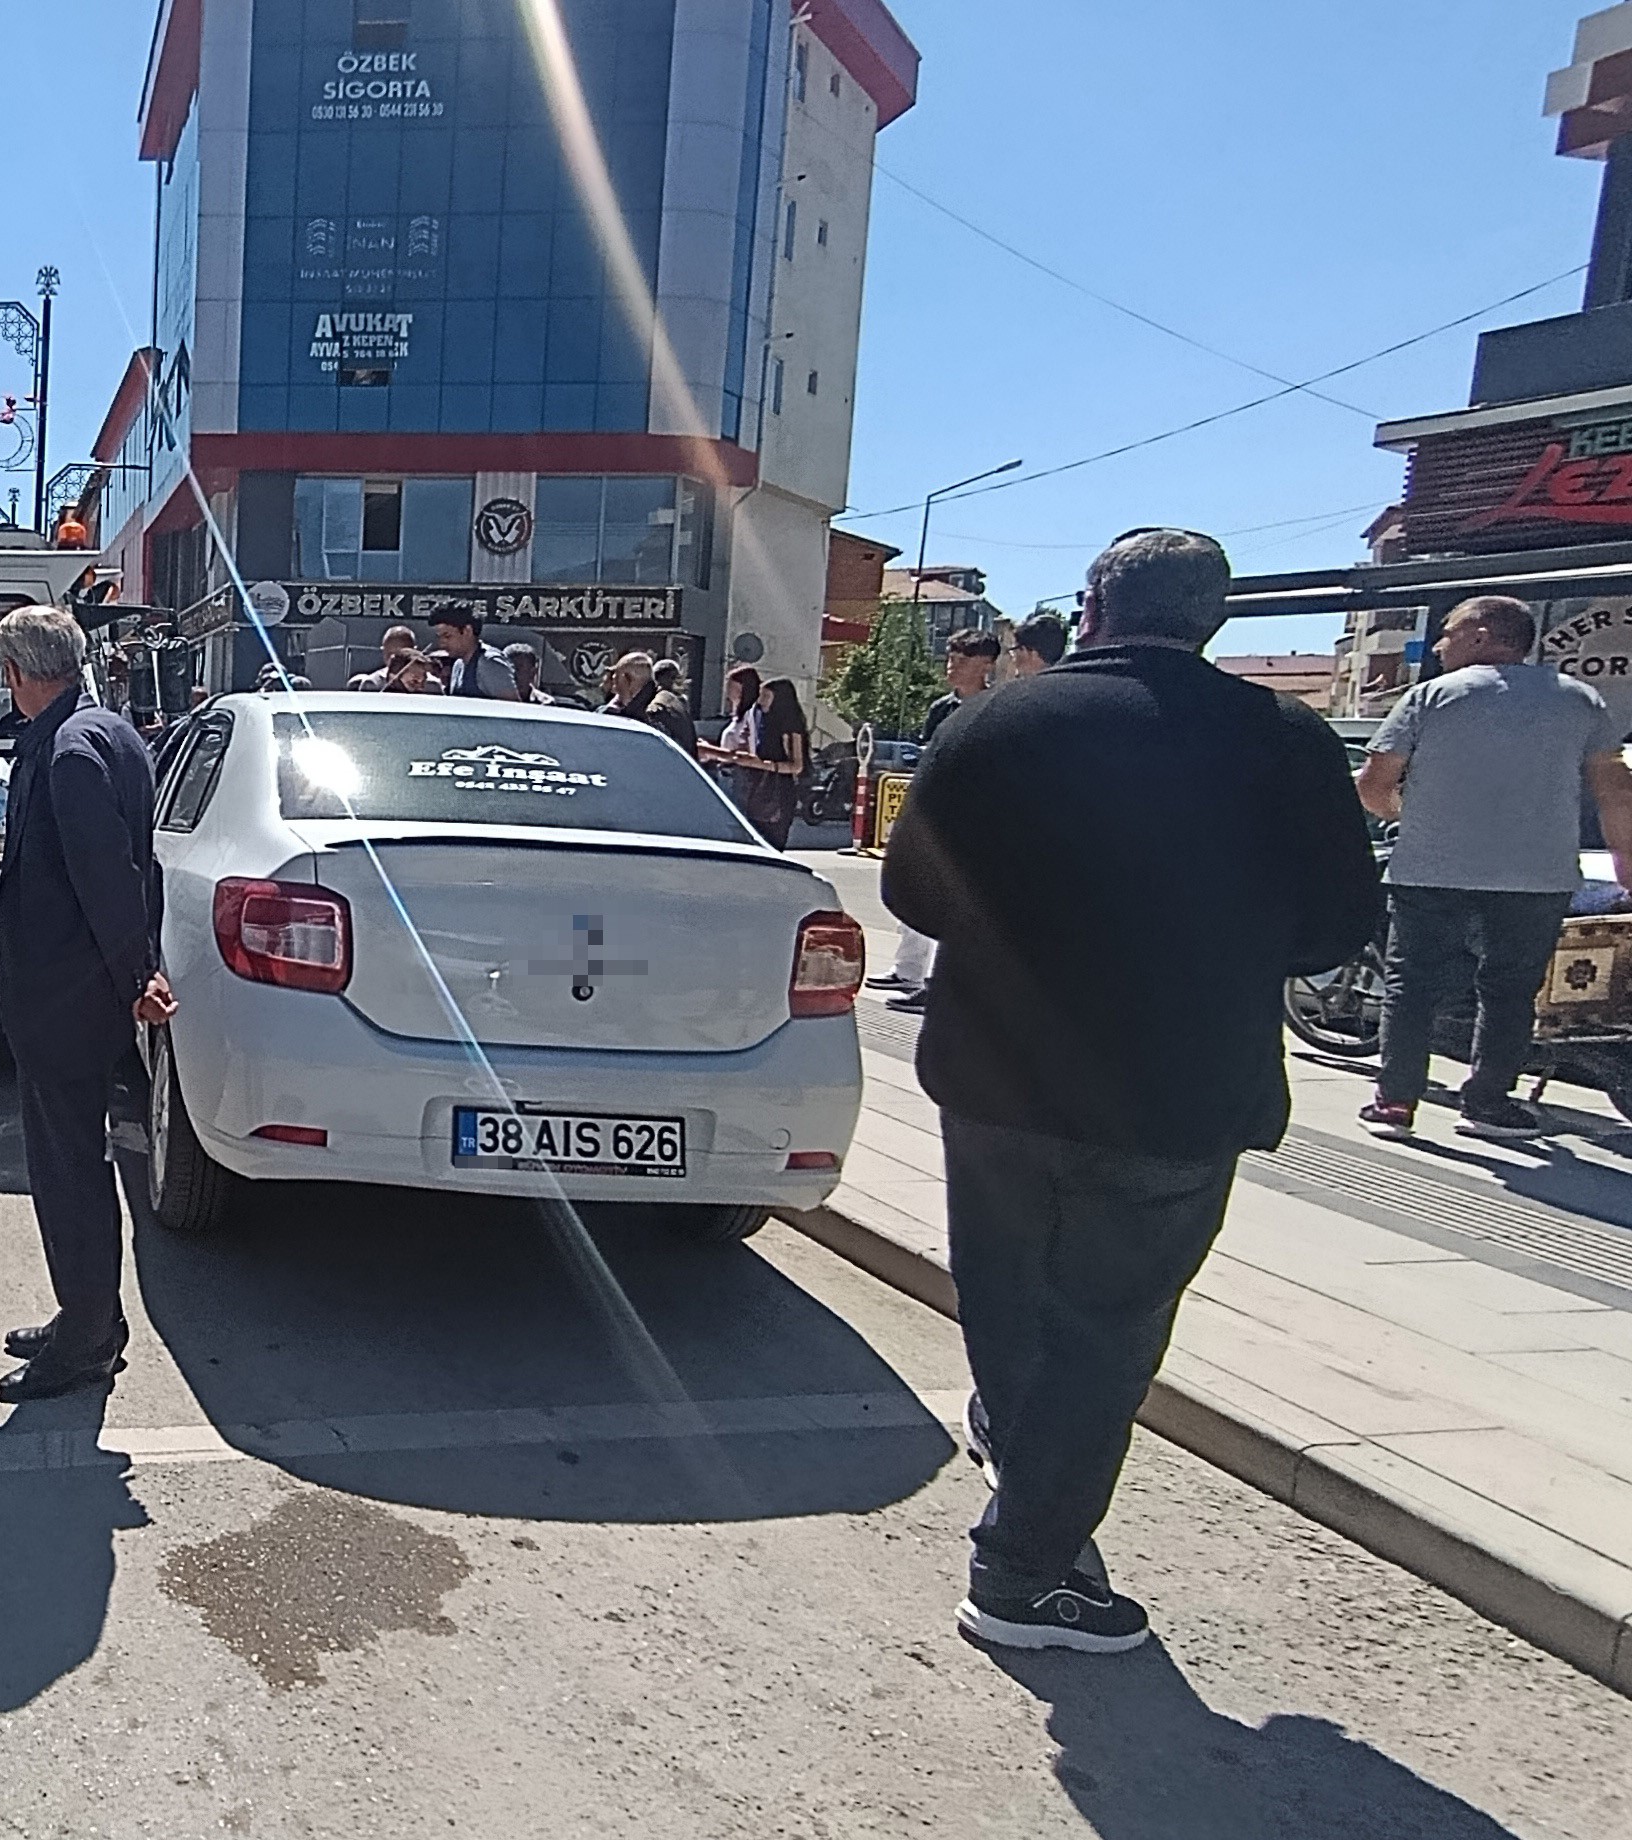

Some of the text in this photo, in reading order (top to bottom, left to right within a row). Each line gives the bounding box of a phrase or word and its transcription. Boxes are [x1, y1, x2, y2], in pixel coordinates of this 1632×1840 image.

[337, 51, 417, 74] ÖZBEK
[323, 79, 430, 99] SİGORTA
[315, 313, 413, 338] AVUKAT
[297, 586, 405, 616] ÖZBEK
[495, 590, 674, 624] ŞARKÜTERİ
[1548, 610, 1613, 650] HER
[407, 760, 609, 787] Efe İnşaat
[461, 1137, 476, 1148] TR
[478, 1116, 679, 1163] 38 AIS 626
